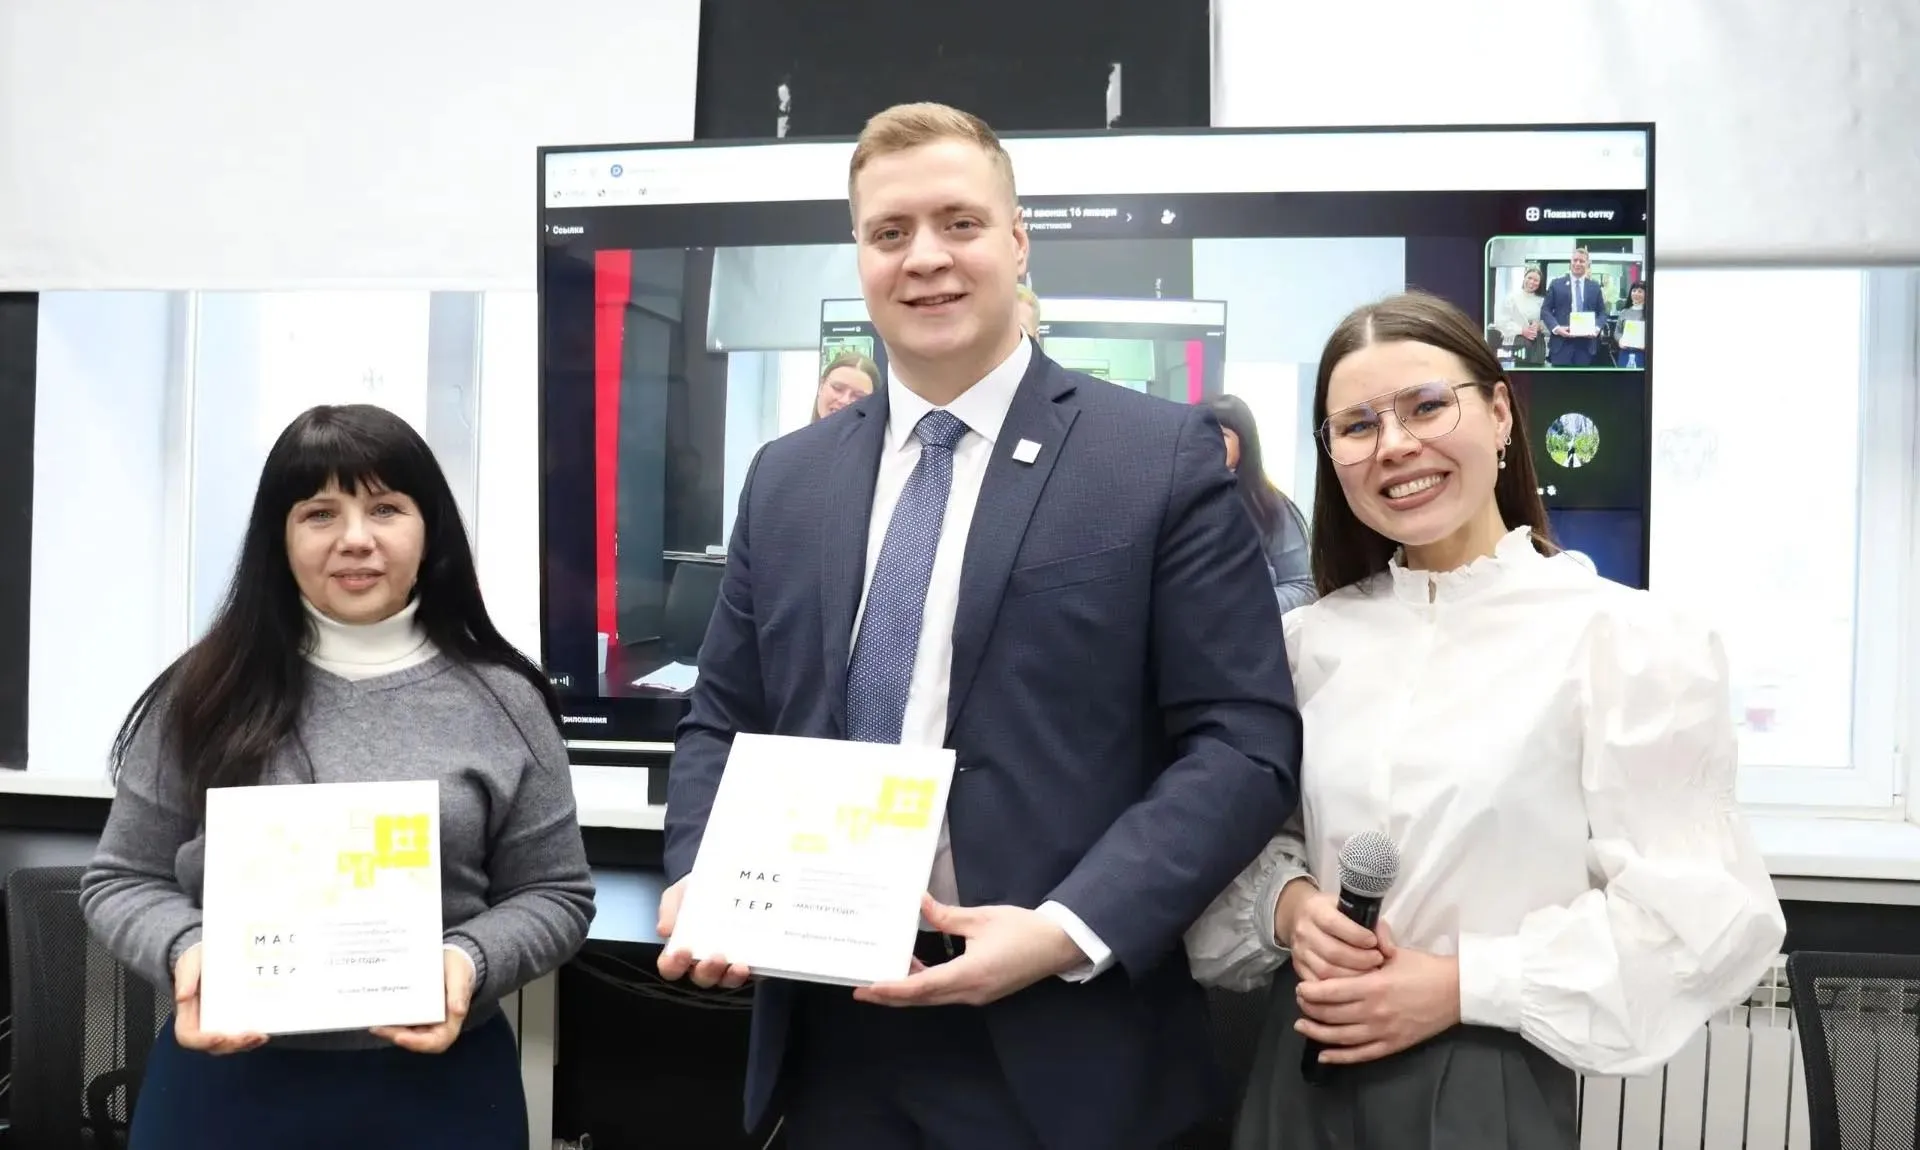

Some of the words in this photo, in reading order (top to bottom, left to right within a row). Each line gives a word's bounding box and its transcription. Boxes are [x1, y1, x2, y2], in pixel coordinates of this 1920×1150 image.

[1070, 206, 1081, 217] 16
[1543, 208, 1587, 219] Показать
[1588, 210, 1614, 220] сетку
[552, 225, 584, 235] Ссылка
[562, 715, 608, 725] риложения
